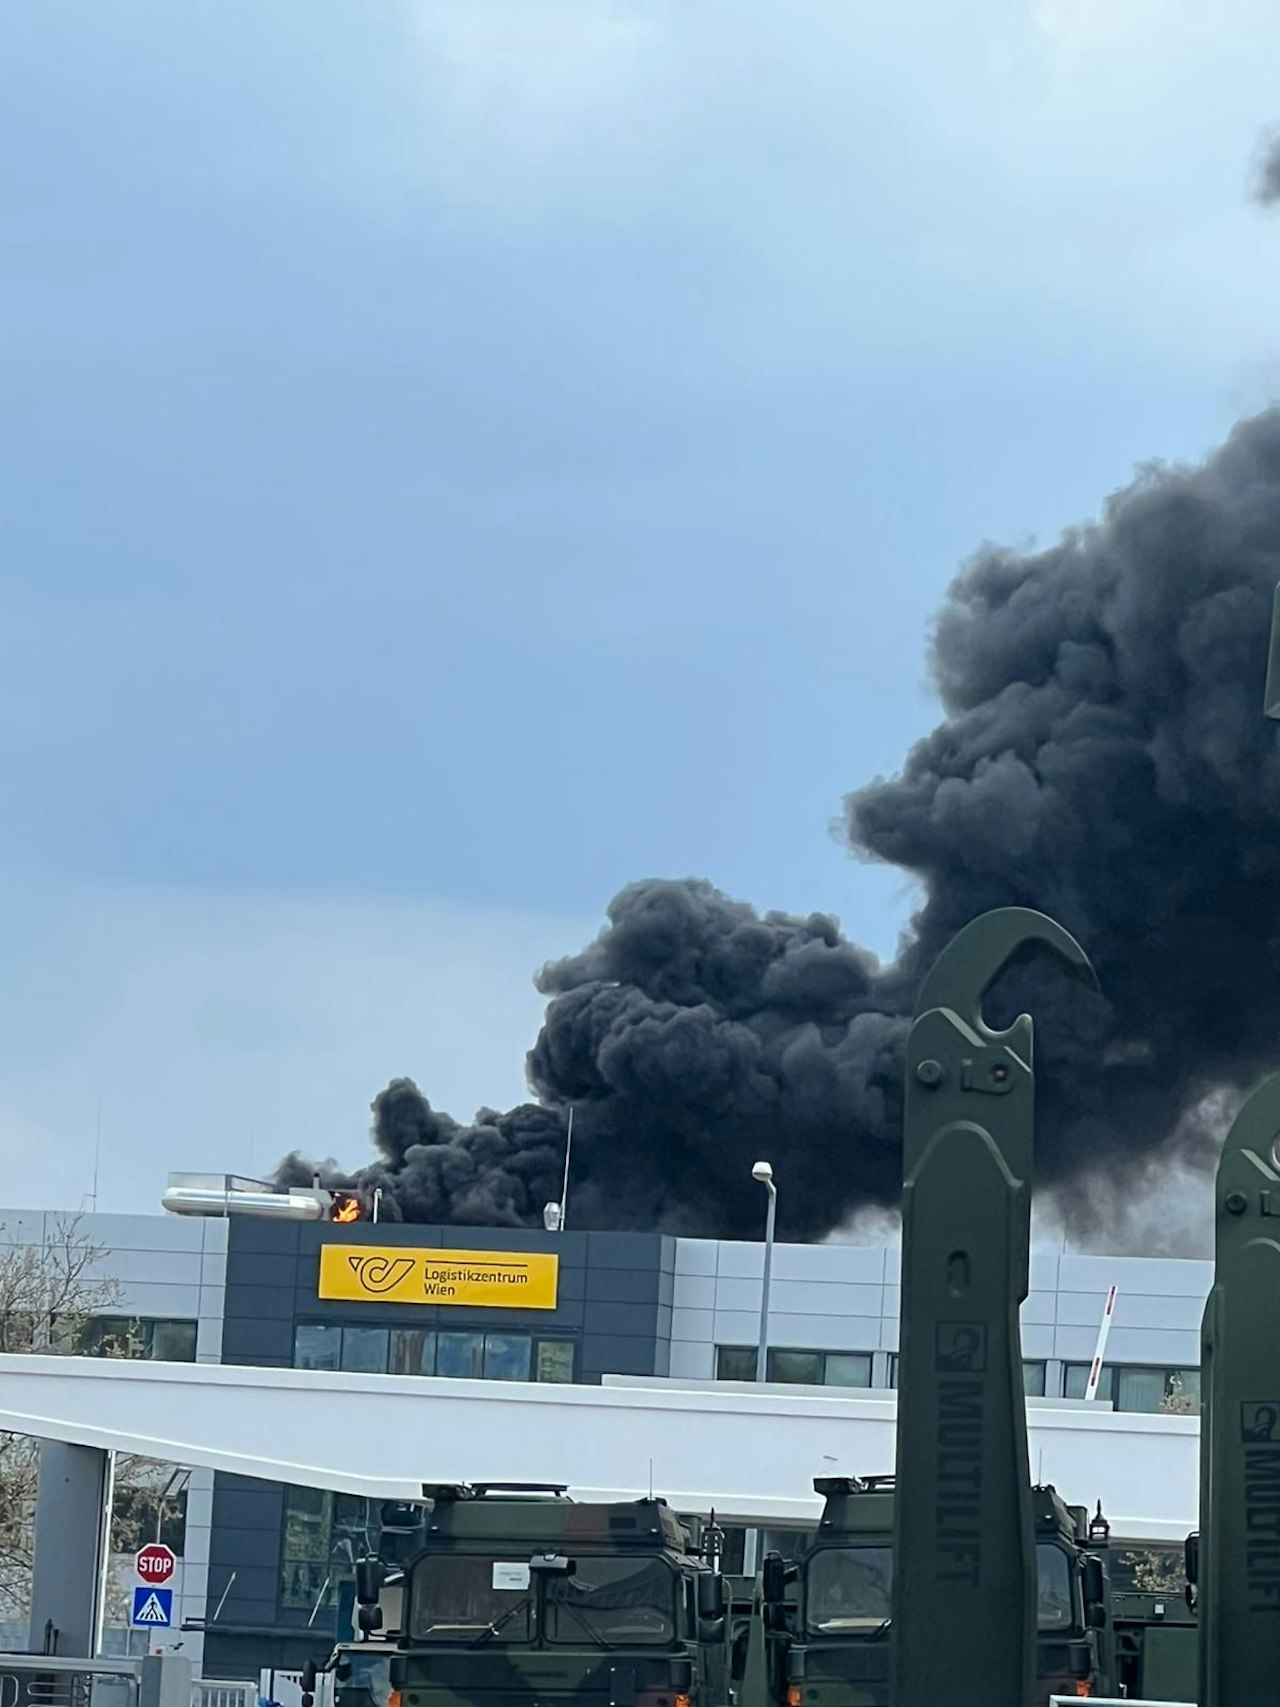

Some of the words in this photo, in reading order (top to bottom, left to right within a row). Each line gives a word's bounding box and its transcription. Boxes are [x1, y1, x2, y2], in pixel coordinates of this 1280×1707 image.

[425, 1267, 528, 1283] Logistikzentrum
[424, 1283, 455, 1296] Wien
[936, 1380, 984, 1588] MULTILIFT
[139, 1556, 172, 1573] STOP
